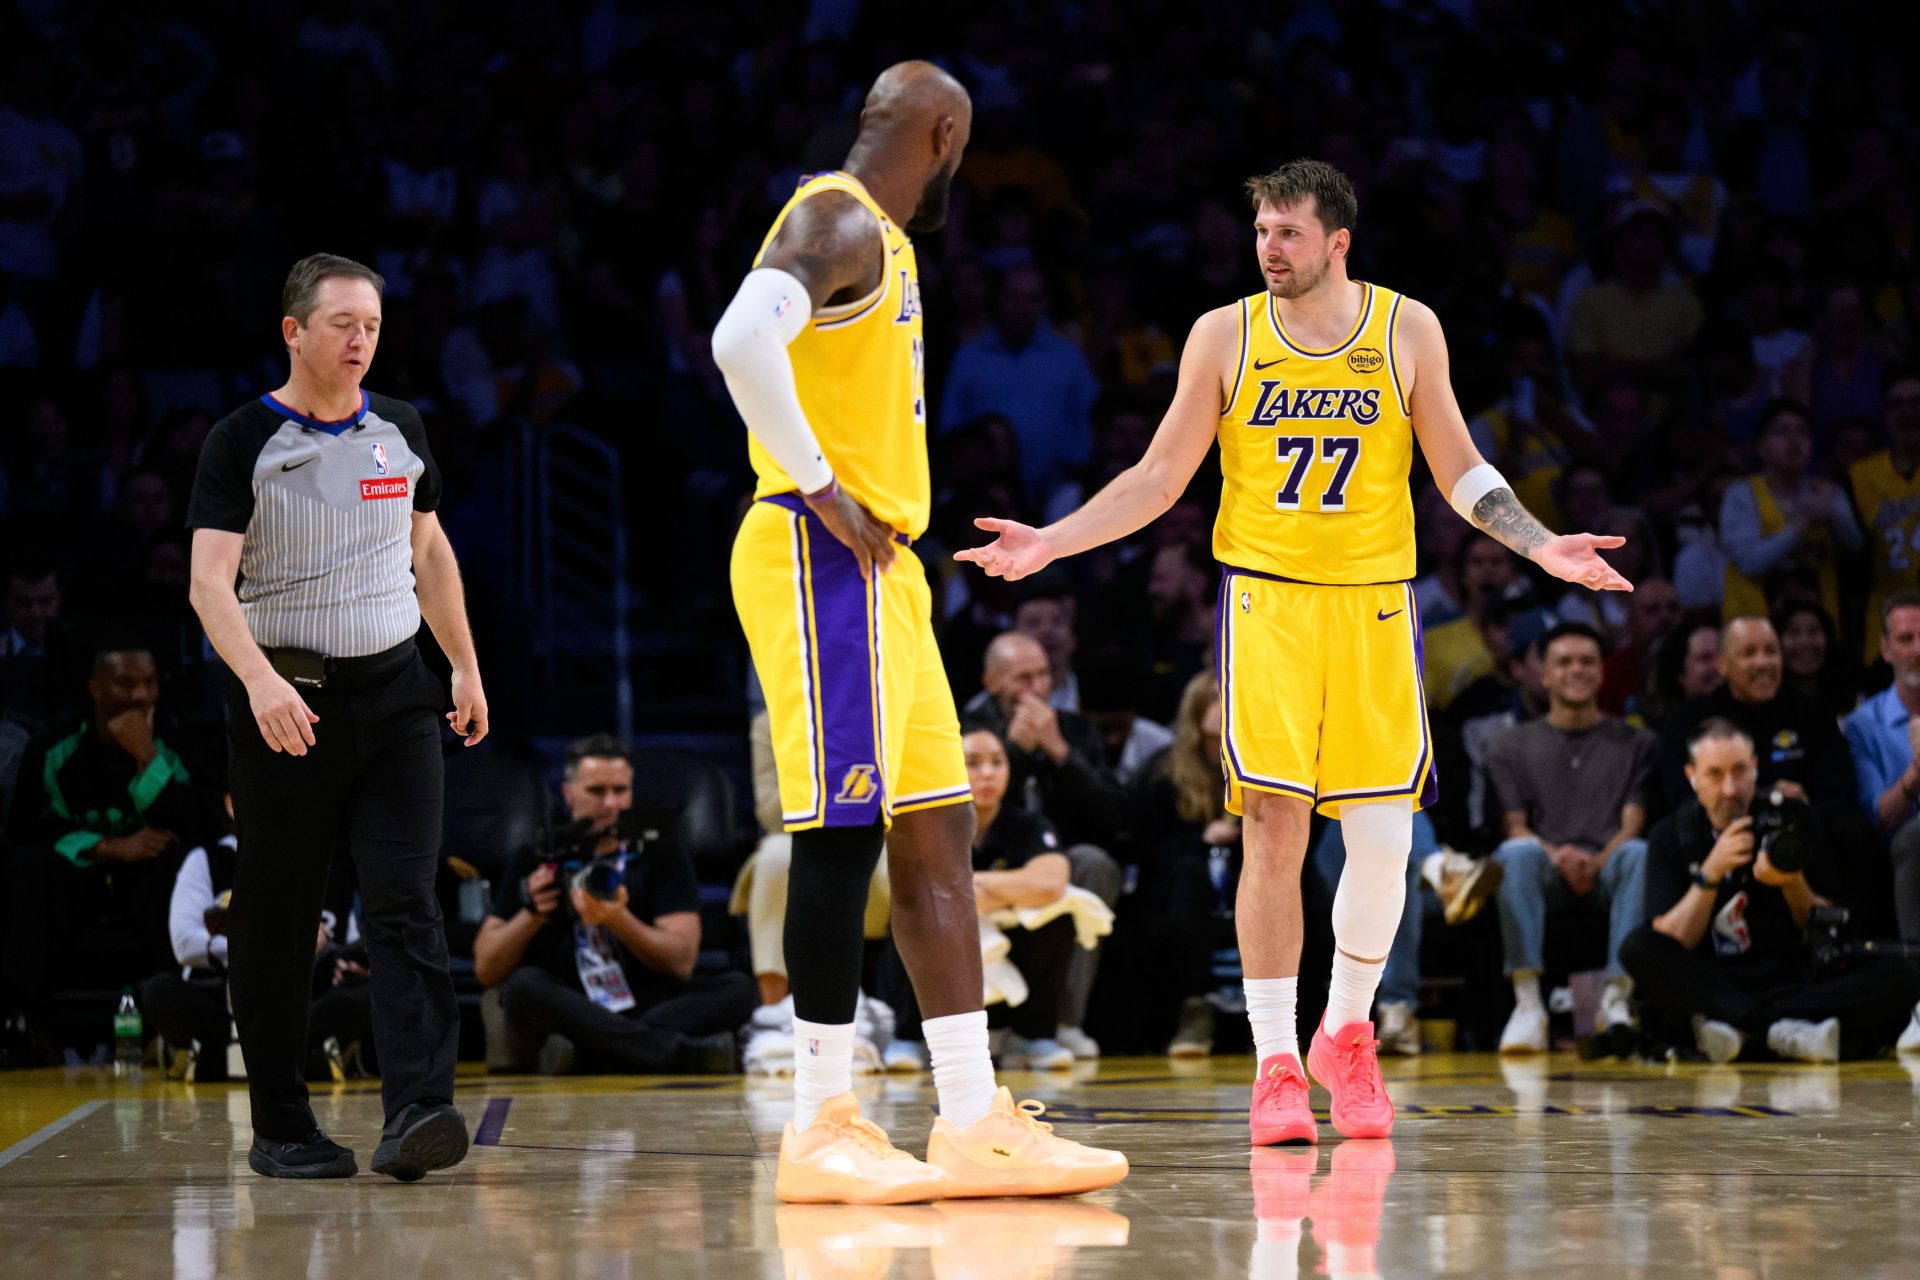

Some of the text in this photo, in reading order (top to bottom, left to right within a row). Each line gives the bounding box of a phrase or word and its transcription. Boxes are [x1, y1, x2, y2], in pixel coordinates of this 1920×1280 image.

[1350, 355, 1382, 366] bibigo
[1246, 379, 1381, 426] LAKERS
[1275, 436, 1361, 511] 77
[362, 483, 408, 497] Emirates
